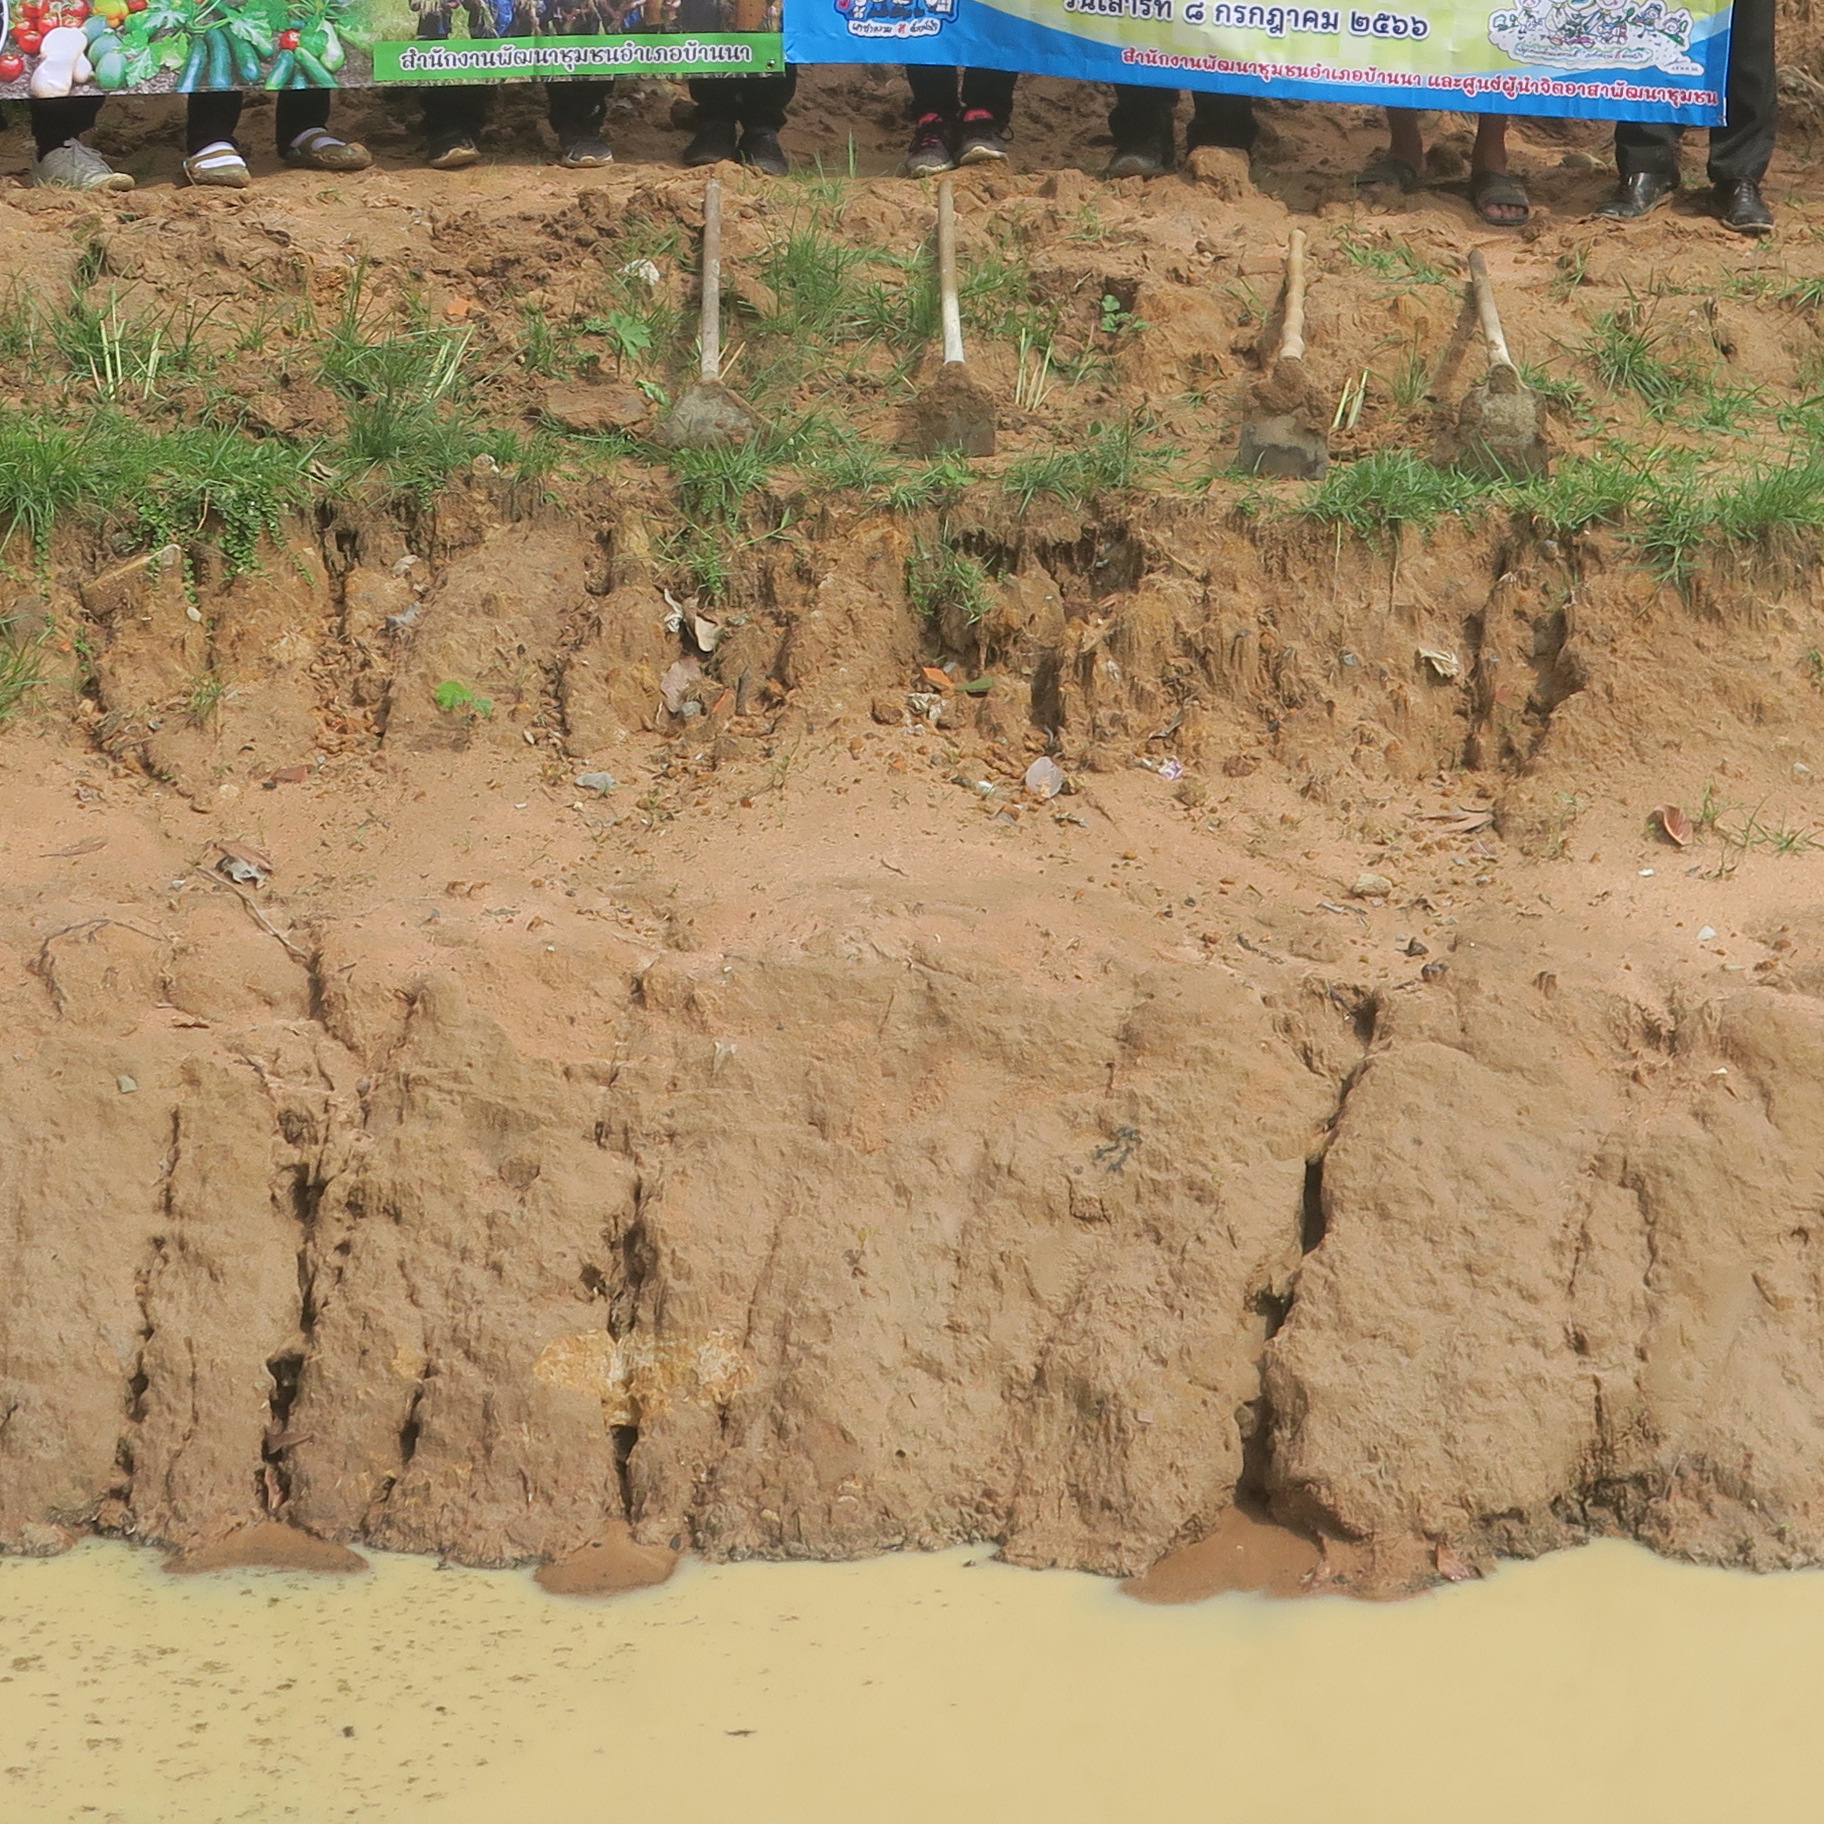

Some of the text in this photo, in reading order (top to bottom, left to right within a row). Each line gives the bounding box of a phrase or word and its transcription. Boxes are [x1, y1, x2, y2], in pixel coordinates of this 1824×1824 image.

[1185, 3, 1205, 21] ๘
[1215, 4, 1339, 35] กรกฎาคม
[1350, 13, 1429, 37] ๒๕๖๖
[401, 41, 751, 71] สำนักงานพัฒนาชุมชนอำเภอบ้านนา
[1123, 48, 1719, 107] สำนักงานพัฒนาชุมชนอำเภอบ้านนา และศูนย์ผู้นำจิตอาสาพัฒนาชุมชน
